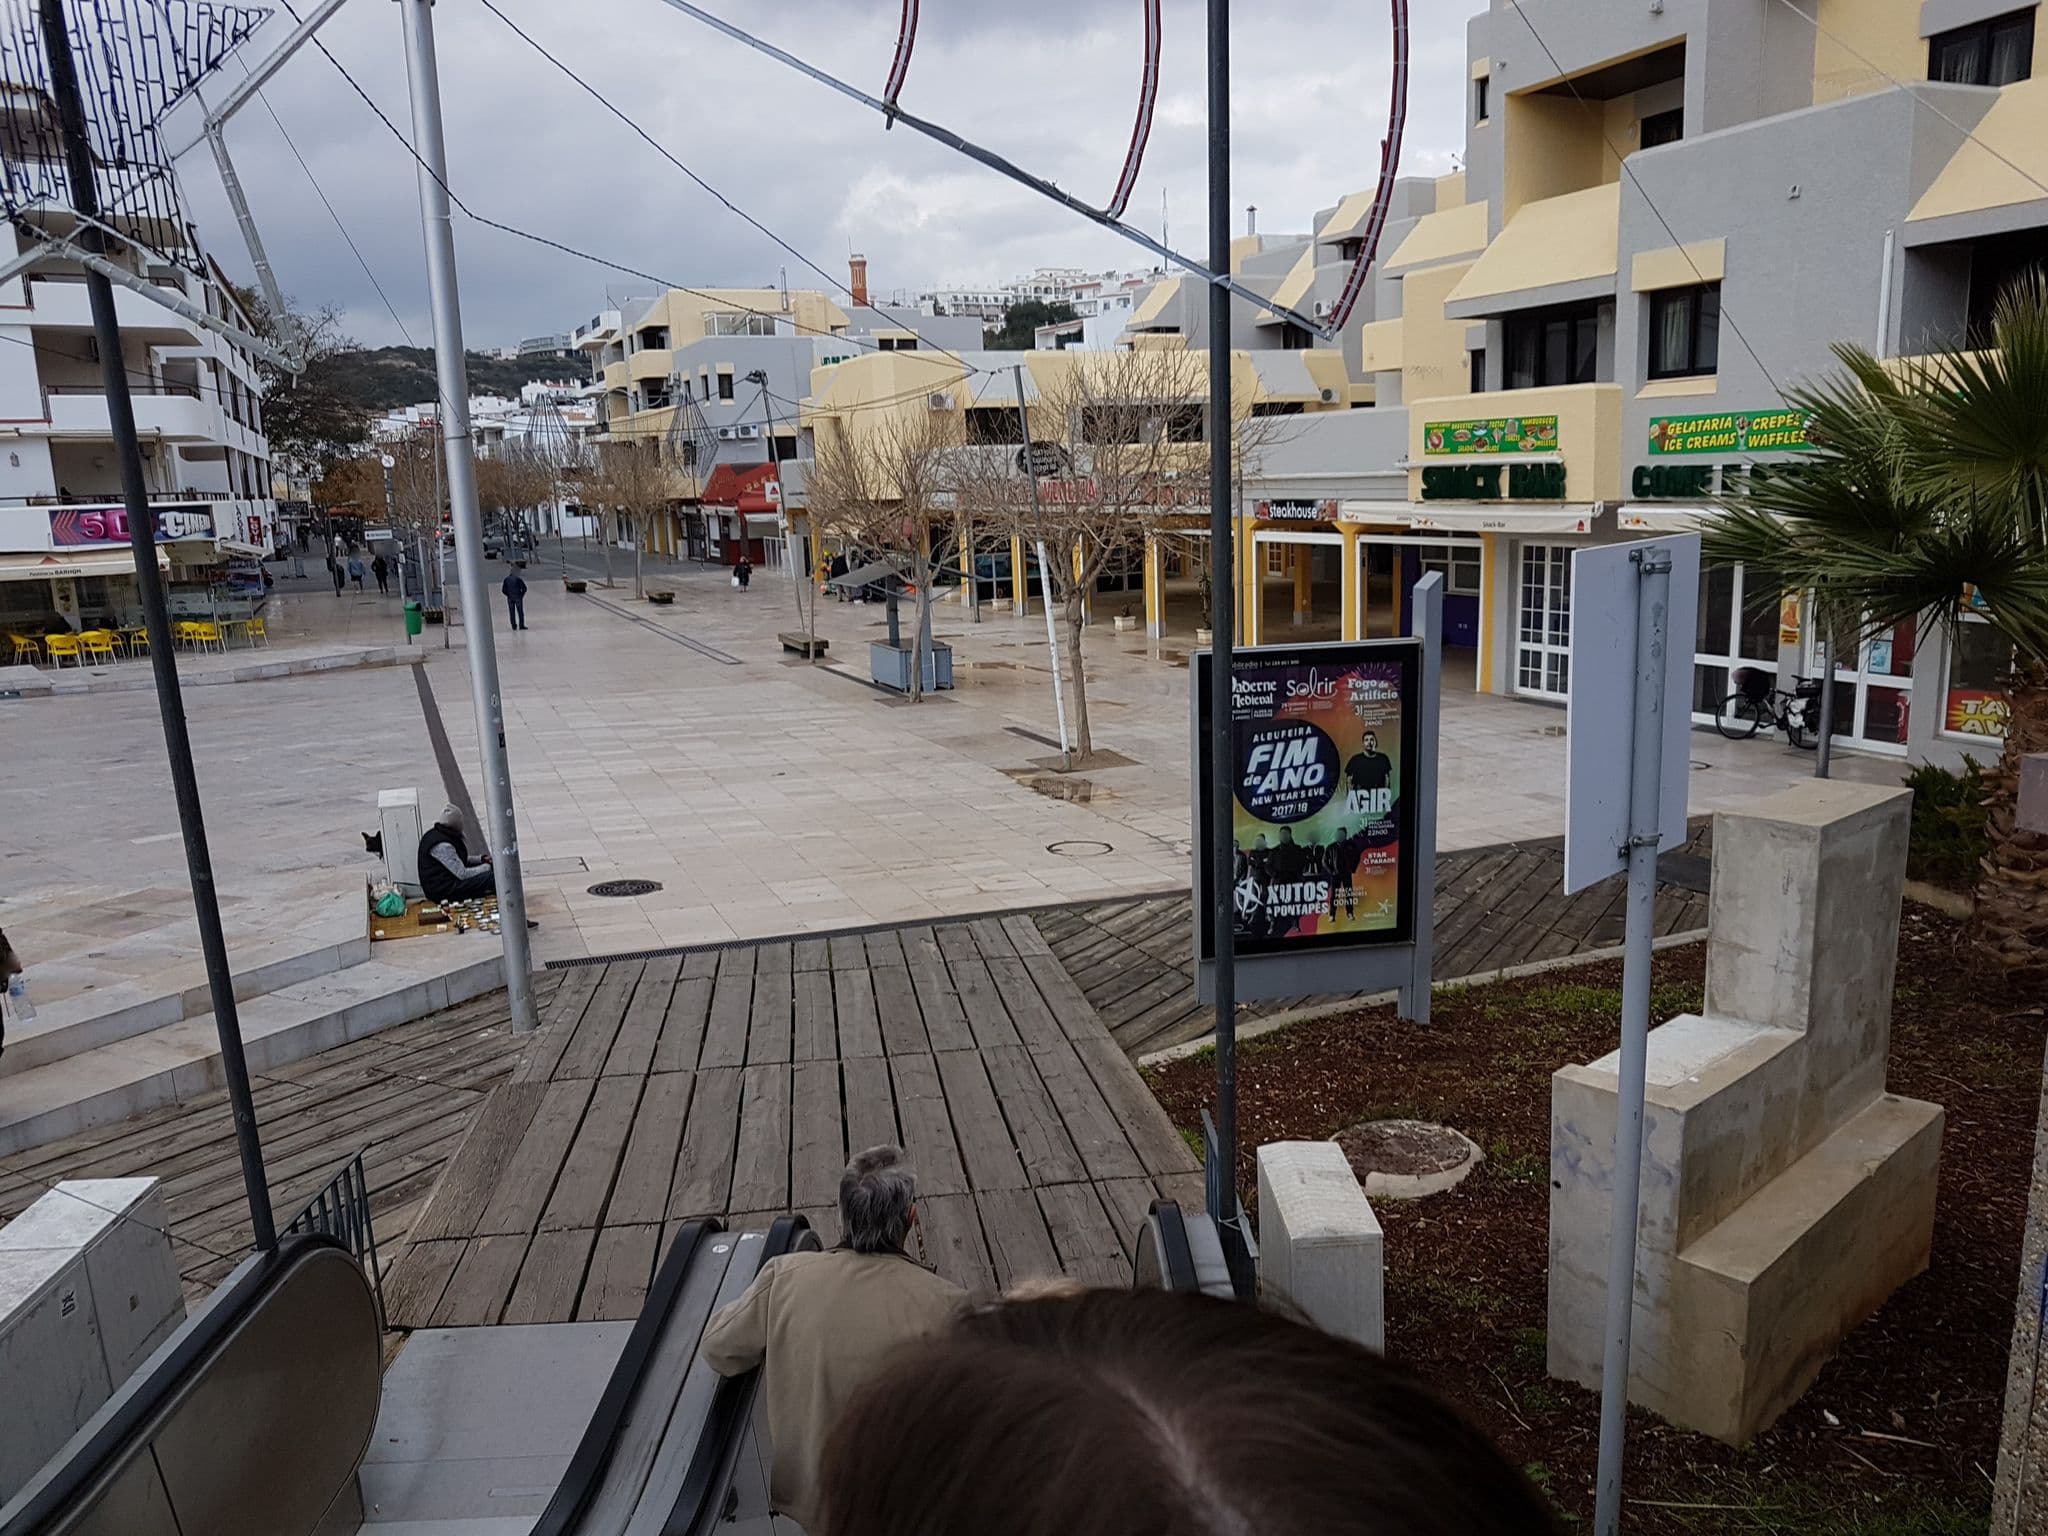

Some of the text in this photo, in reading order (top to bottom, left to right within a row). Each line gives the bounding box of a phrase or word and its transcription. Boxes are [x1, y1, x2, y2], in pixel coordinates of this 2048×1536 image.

[1667, 416, 1732, 435] GELATARIA
[1664, 430, 1807, 451] ICE CREAMS WAFFLES
[1508, 463, 1566, 499] BAR
[1269, 502, 1317, 519] steakhouse
[1348, 678, 1377, 690] Fogo
[1253, 726, 1312, 743] ALBUFEIRA
[1247, 736, 1318, 774] FIM
[1243, 763, 1325, 794] de ANO
[1251, 787, 1325, 806] NEW YEAR'S EVE
[1345, 787, 1392, 814] AGIR
[1271, 802, 1308, 817] 2017/18
[1267, 881, 1328, 905] XUTOS
